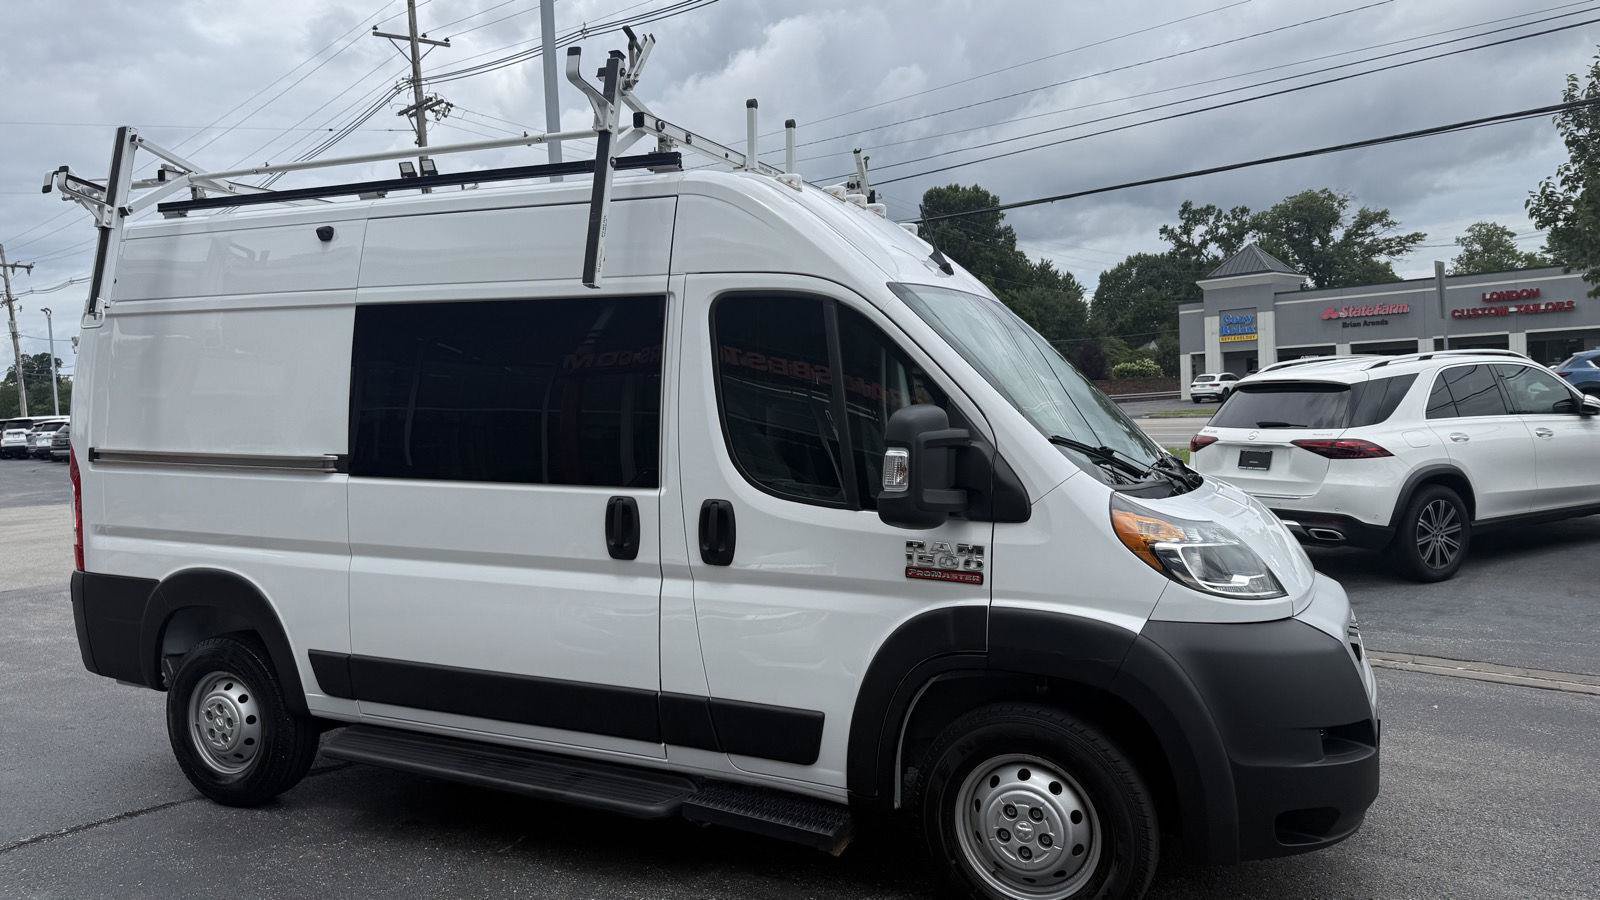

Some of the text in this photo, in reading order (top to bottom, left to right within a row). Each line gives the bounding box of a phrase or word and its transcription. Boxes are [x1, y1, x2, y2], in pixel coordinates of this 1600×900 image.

[1482, 288, 1541, 302] LONDON
[1451, 300, 1577, 320] CUSTOM TAILORS
[905, 540, 985, 557] RAM
[906, 553, 984, 571] 1500
[907, 568, 981, 582] PROMASTER
